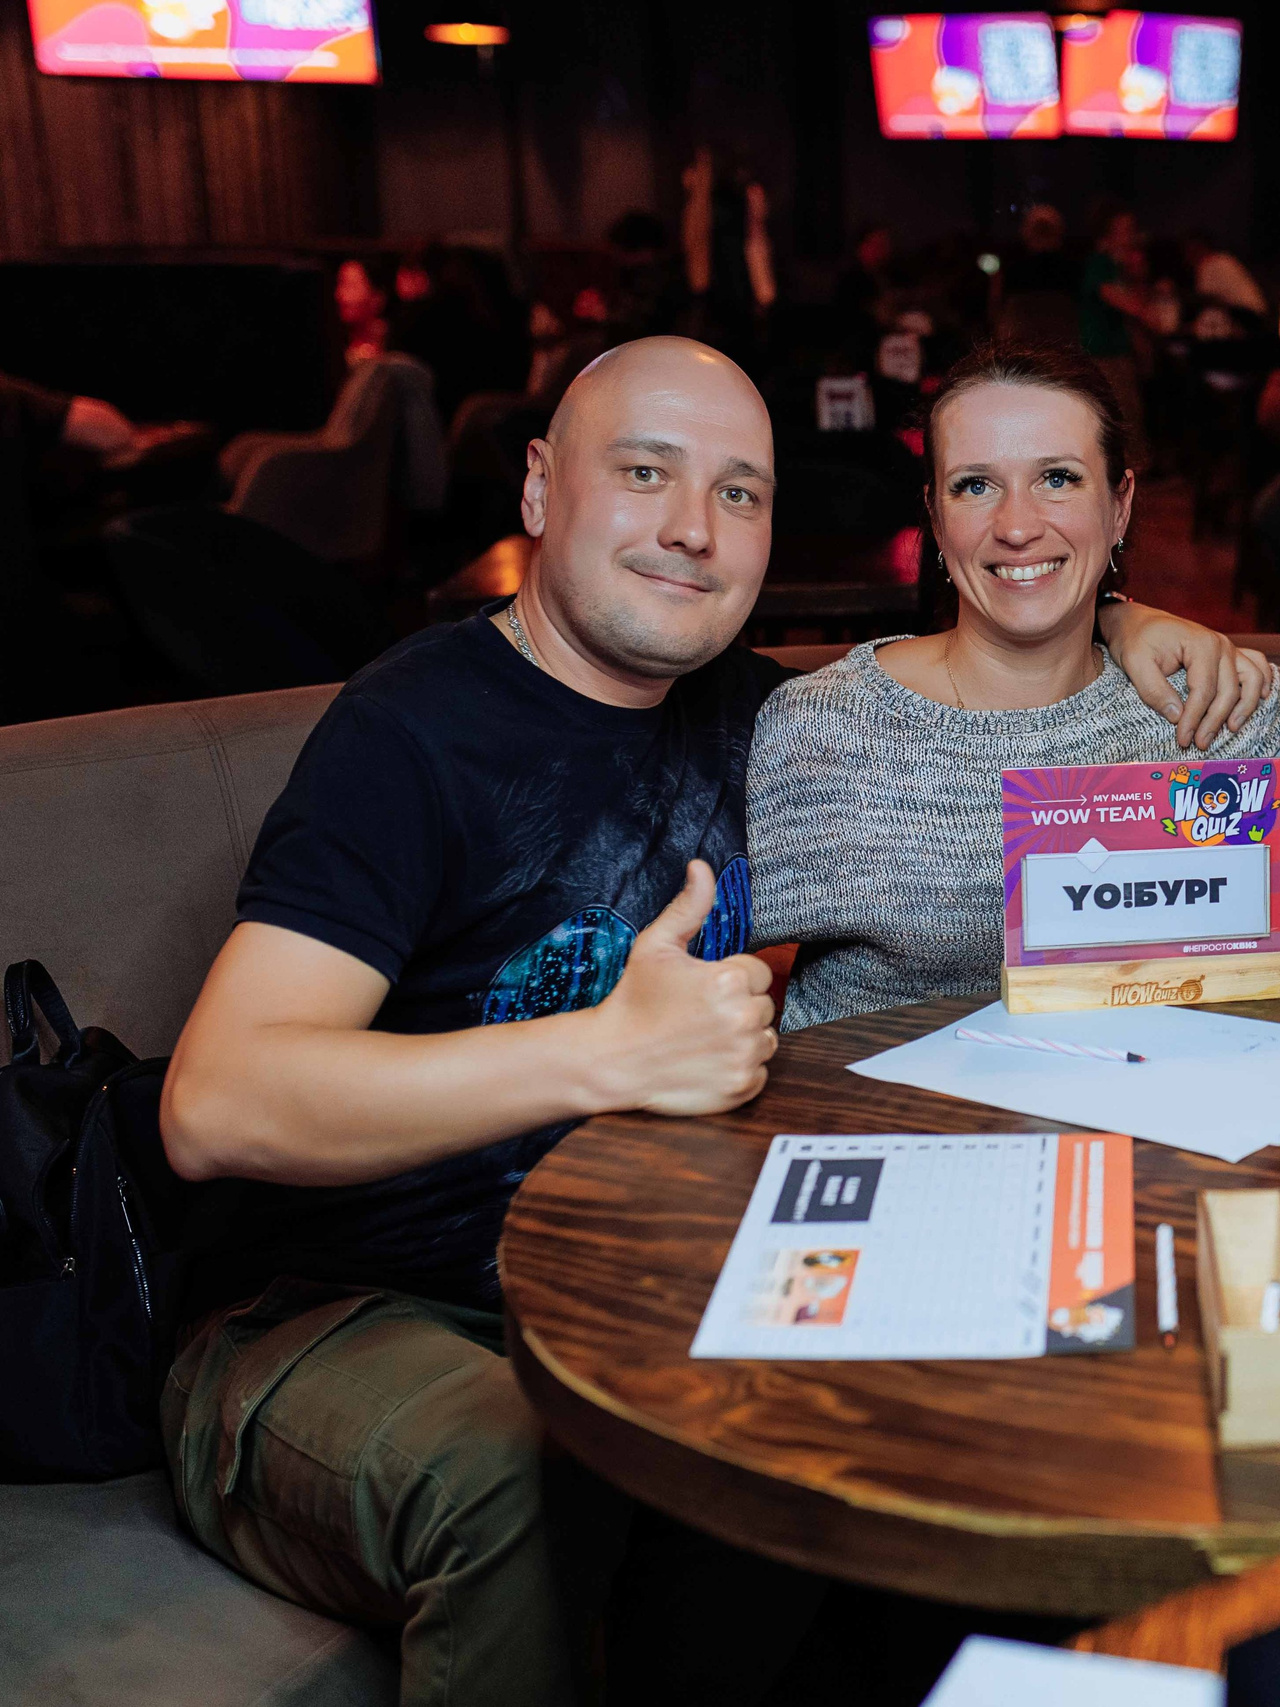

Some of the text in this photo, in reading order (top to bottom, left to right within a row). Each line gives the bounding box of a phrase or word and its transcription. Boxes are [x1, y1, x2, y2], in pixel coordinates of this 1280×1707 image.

[1093, 792, 1153, 803] MY NAME IS
[1031, 805, 1156, 826] WOW TEAM
[1191, 811, 1243, 843] QUIZ
[1062, 877, 1228, 912] YO!БУРГ
[1112, 982, 1180, 1006] WOW QUIZ
